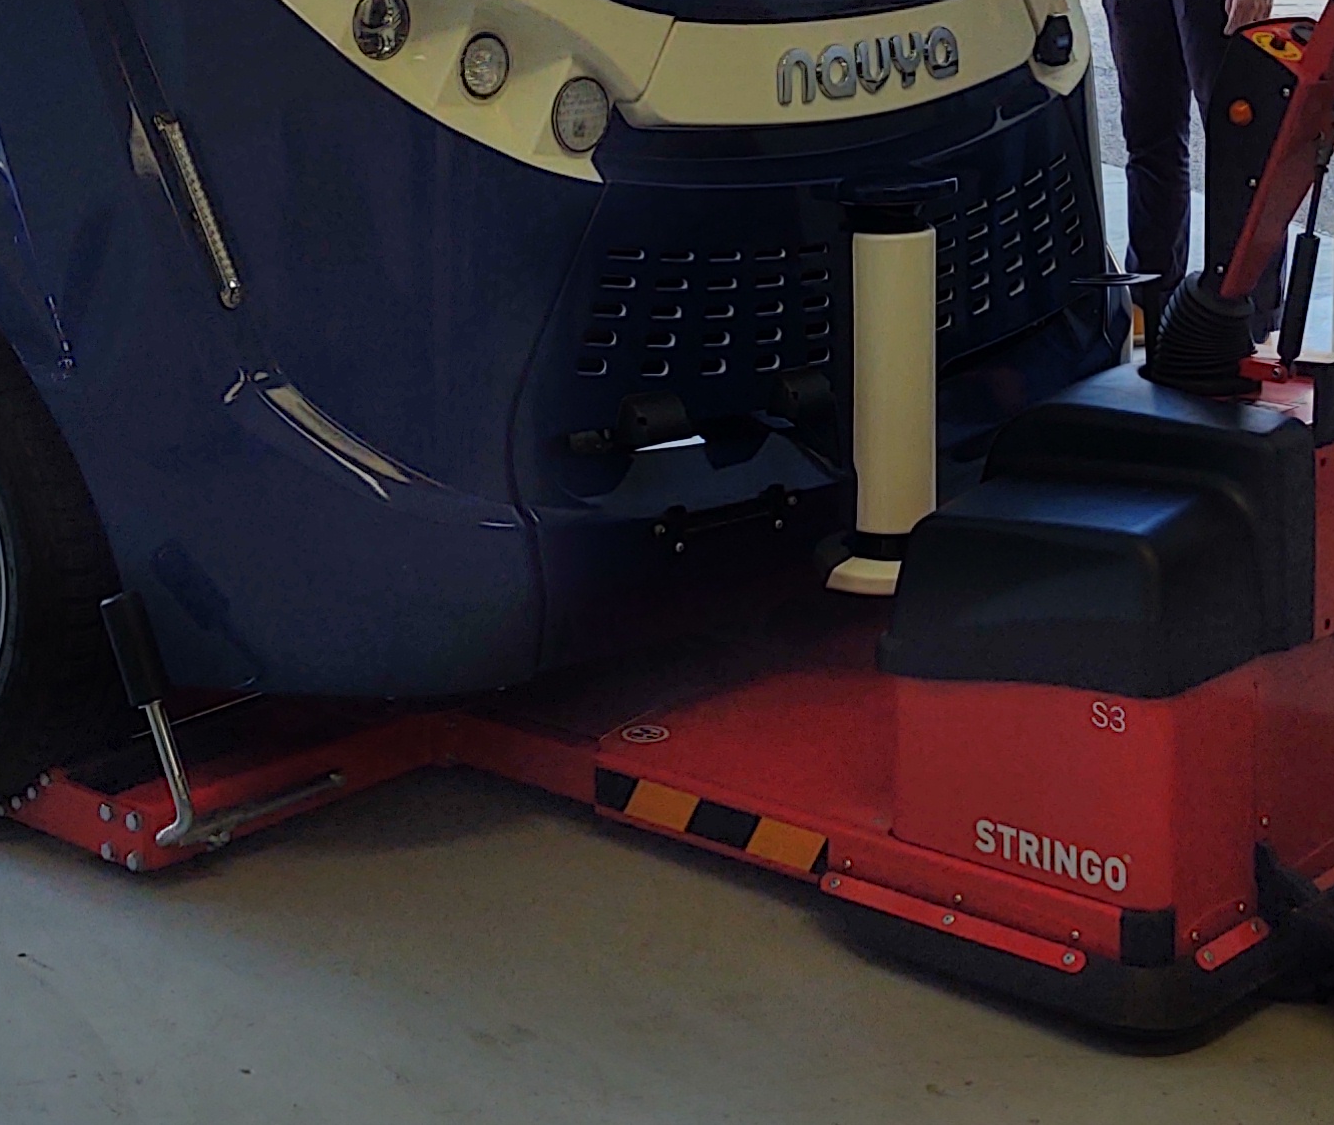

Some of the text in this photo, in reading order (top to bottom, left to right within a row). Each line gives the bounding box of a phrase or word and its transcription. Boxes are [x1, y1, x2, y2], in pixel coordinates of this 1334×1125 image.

[777, 25, 959, 106] navya
[1091, 701, 1126, 732] S3
[975, 819, 1127, 892] STRINGO
